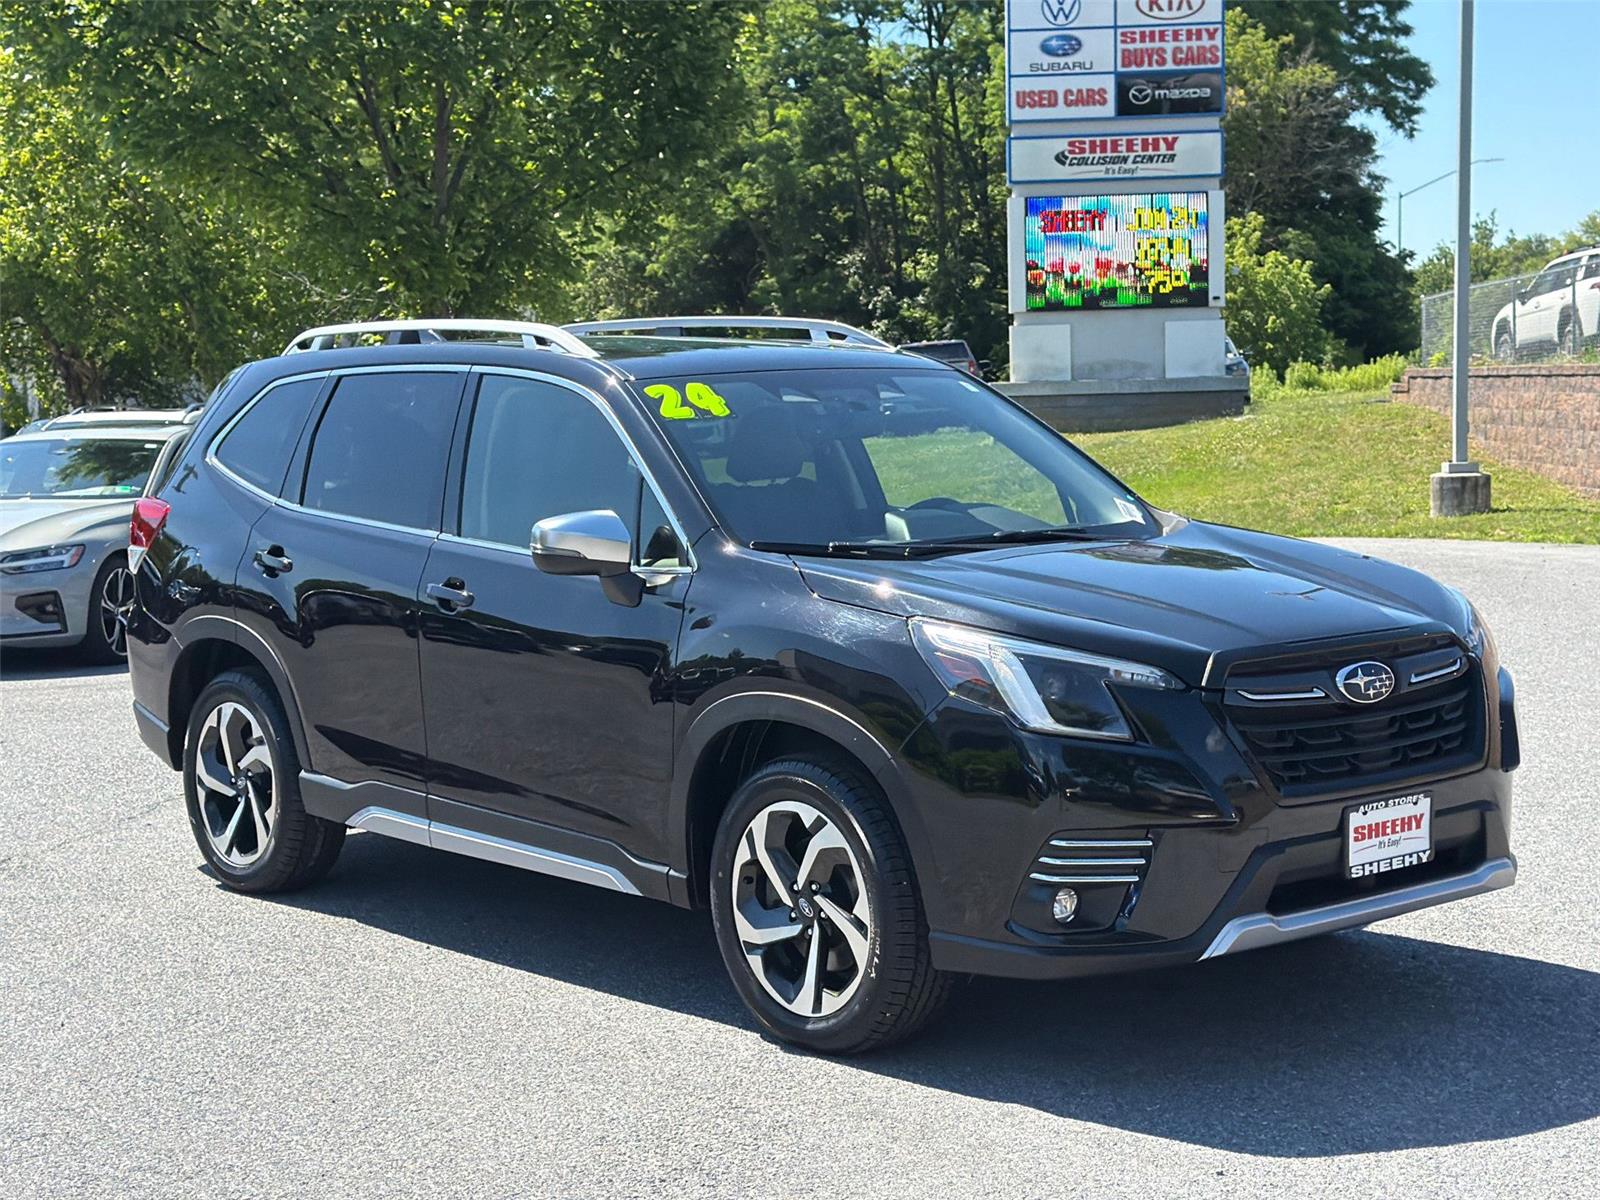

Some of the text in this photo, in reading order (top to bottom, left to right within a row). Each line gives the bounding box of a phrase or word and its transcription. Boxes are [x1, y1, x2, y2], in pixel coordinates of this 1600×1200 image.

[1120, 27, 1220, 44] SHEEHY
[1121, 45, 1220, 68] BUYS CARS
[1029, 61, 1093, 72] SUBARU
[1016, 87, 1108, 109] USED CARS
[1154, 88, 1211, 99] mazda
[1067, 137, 1179, 155] SHEEHY
[1068, 154, 1177, 167] COLLISION CENTER
[1104, 166, 1139, 175] It's Easy!
[643, 382, 731, 419] 24
[1359, 794, 1425, 813] AUTO STORES
[1353, 813, 1424, 843] SHEEHY
[1377, 836, 1402, 849] It's Easy!
[1350, 850, 1431, 878] SHEEHY
